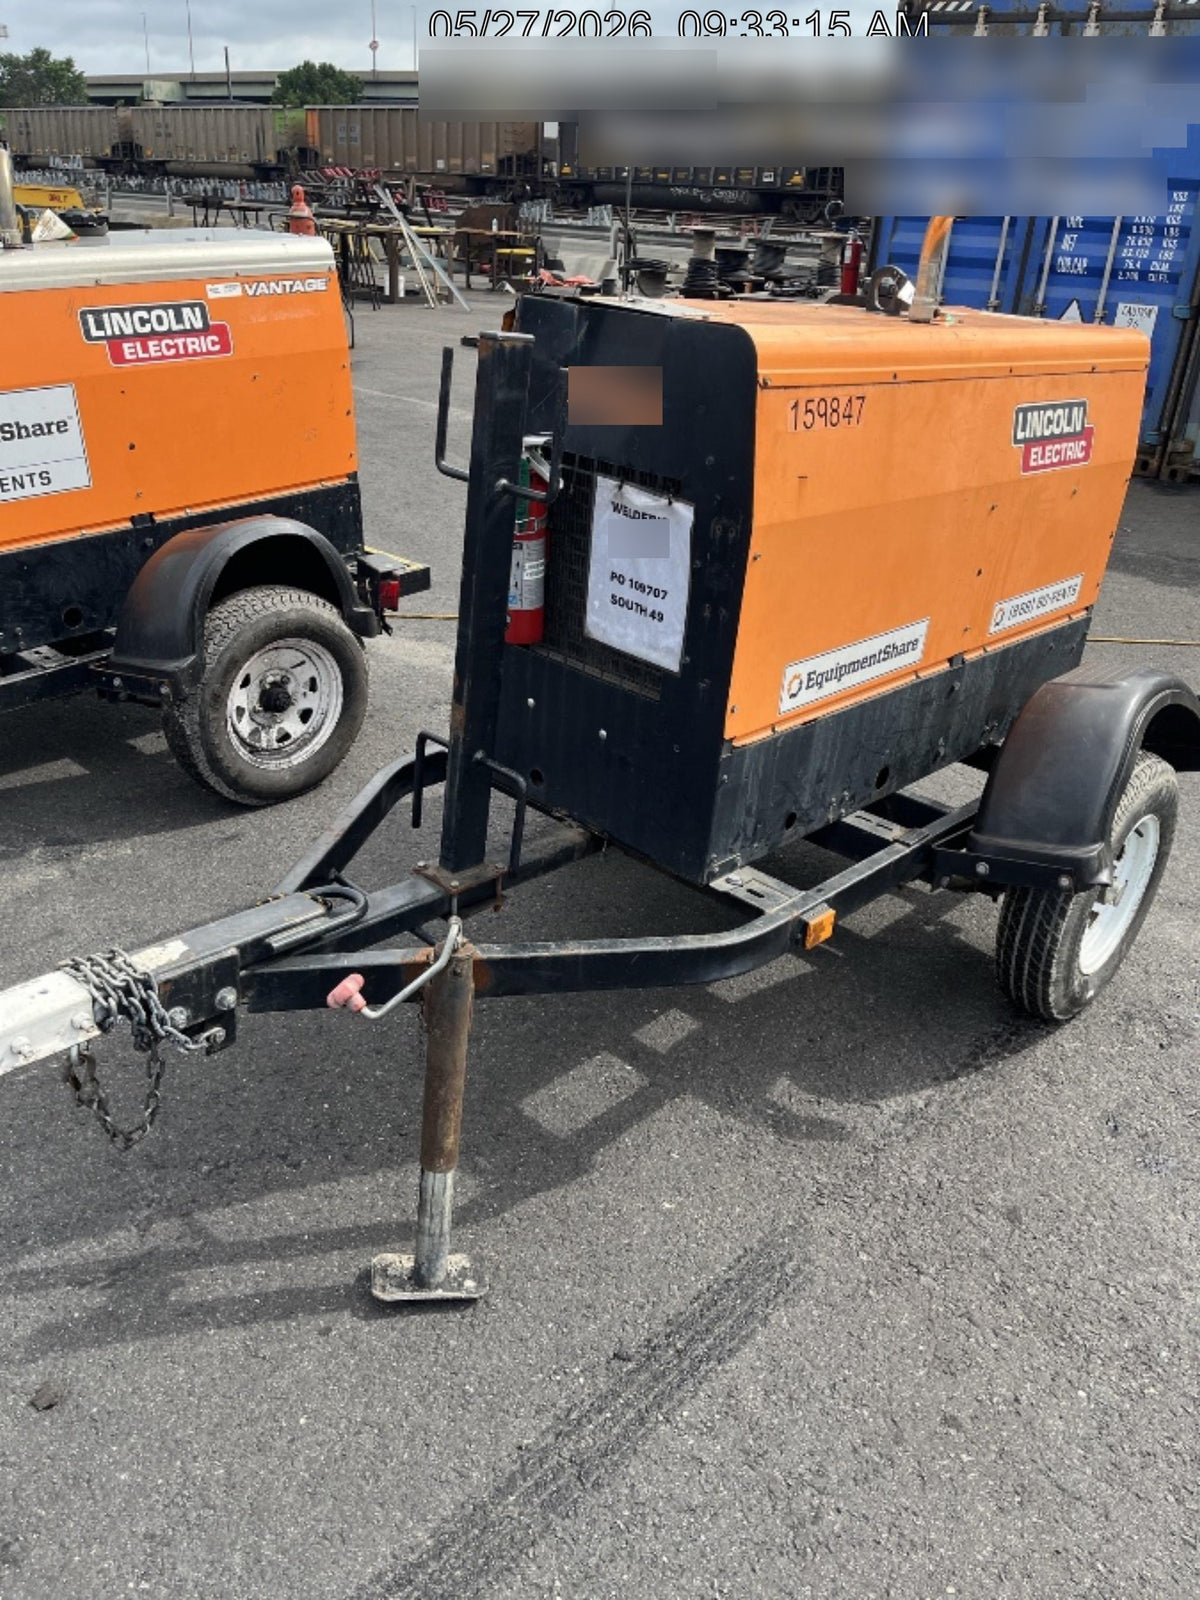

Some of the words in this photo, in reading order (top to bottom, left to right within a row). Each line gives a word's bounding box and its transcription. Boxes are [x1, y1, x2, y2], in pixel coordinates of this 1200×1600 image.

[244, 278, 328, 296] VANTAGE
[87, 307, 203, 337] LINCOLN
[122, 335, 221, 360] ELECTRIC
[790, 396, 866, 431] 159847
[1017, 407, 1083, 440] LINCOLN
[1029, 441, 1087, 467] ELECTRIC
[610, 571, 625, 586] PO
[629, 578, 668, 600] 109707
[611, 594, 648, 618] SOUTH
[648, 609, 664, 623] 49
[805, 638, 919, 689] EquipmentShare
